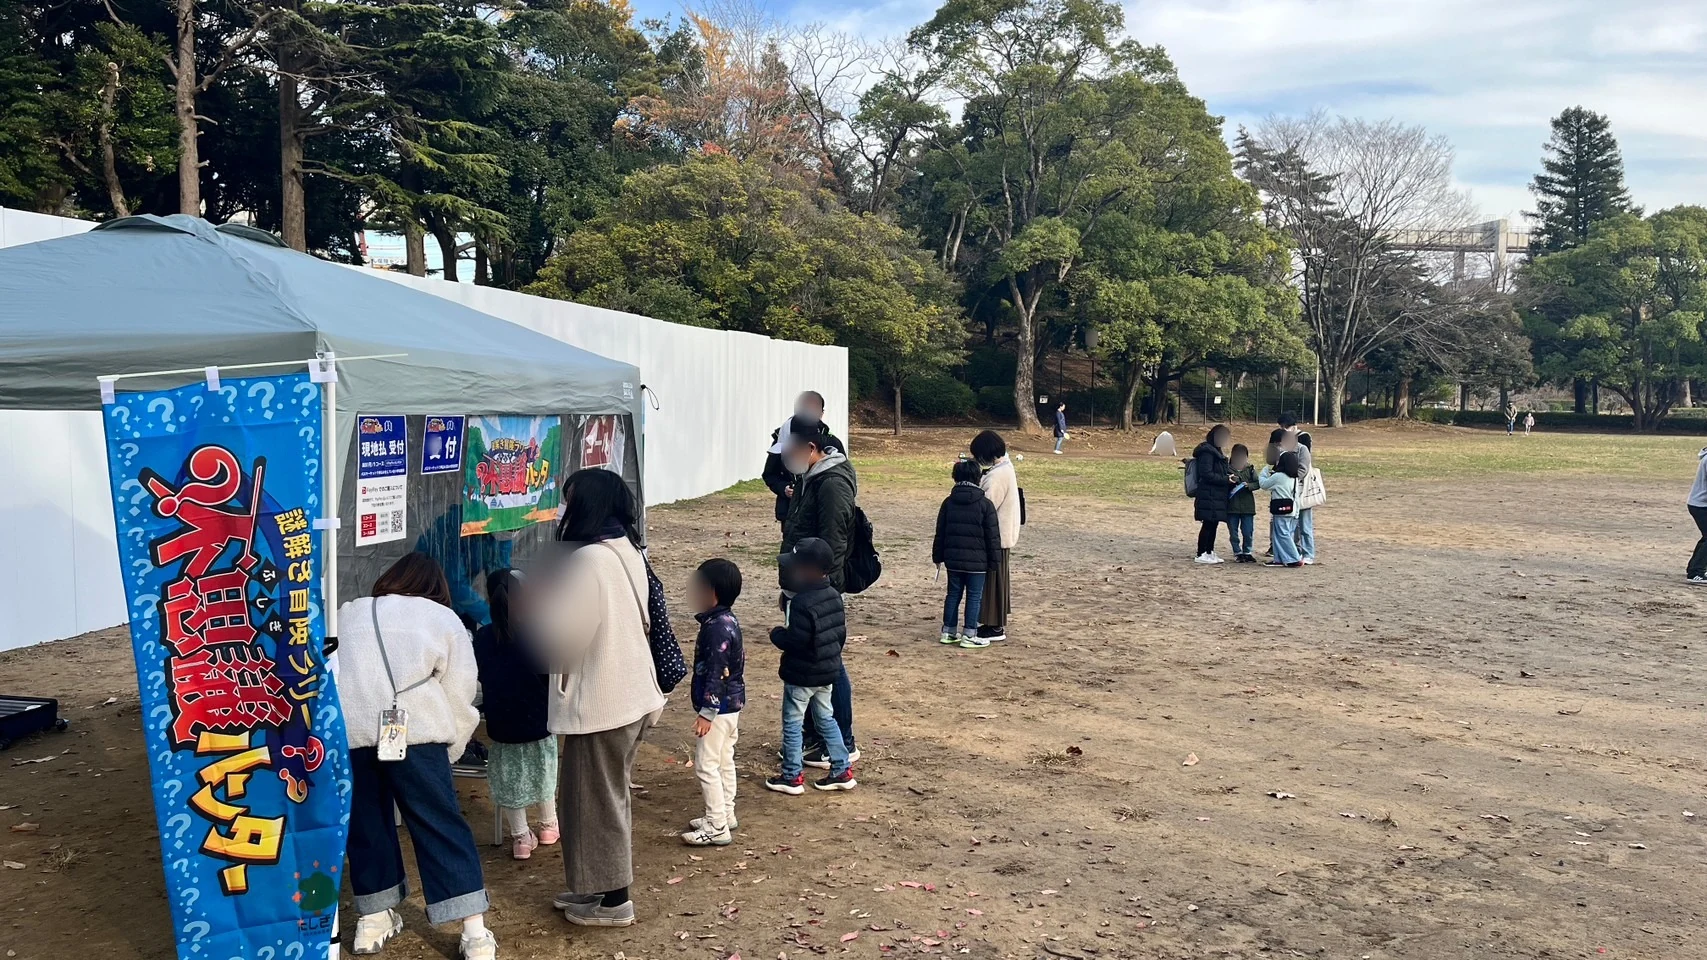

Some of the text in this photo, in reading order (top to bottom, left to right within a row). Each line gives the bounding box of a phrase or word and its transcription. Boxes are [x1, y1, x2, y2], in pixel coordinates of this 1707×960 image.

[361, 440, 404, 457] 現地払 受付
[148, 446, 293, 892] 不思議ハンター
